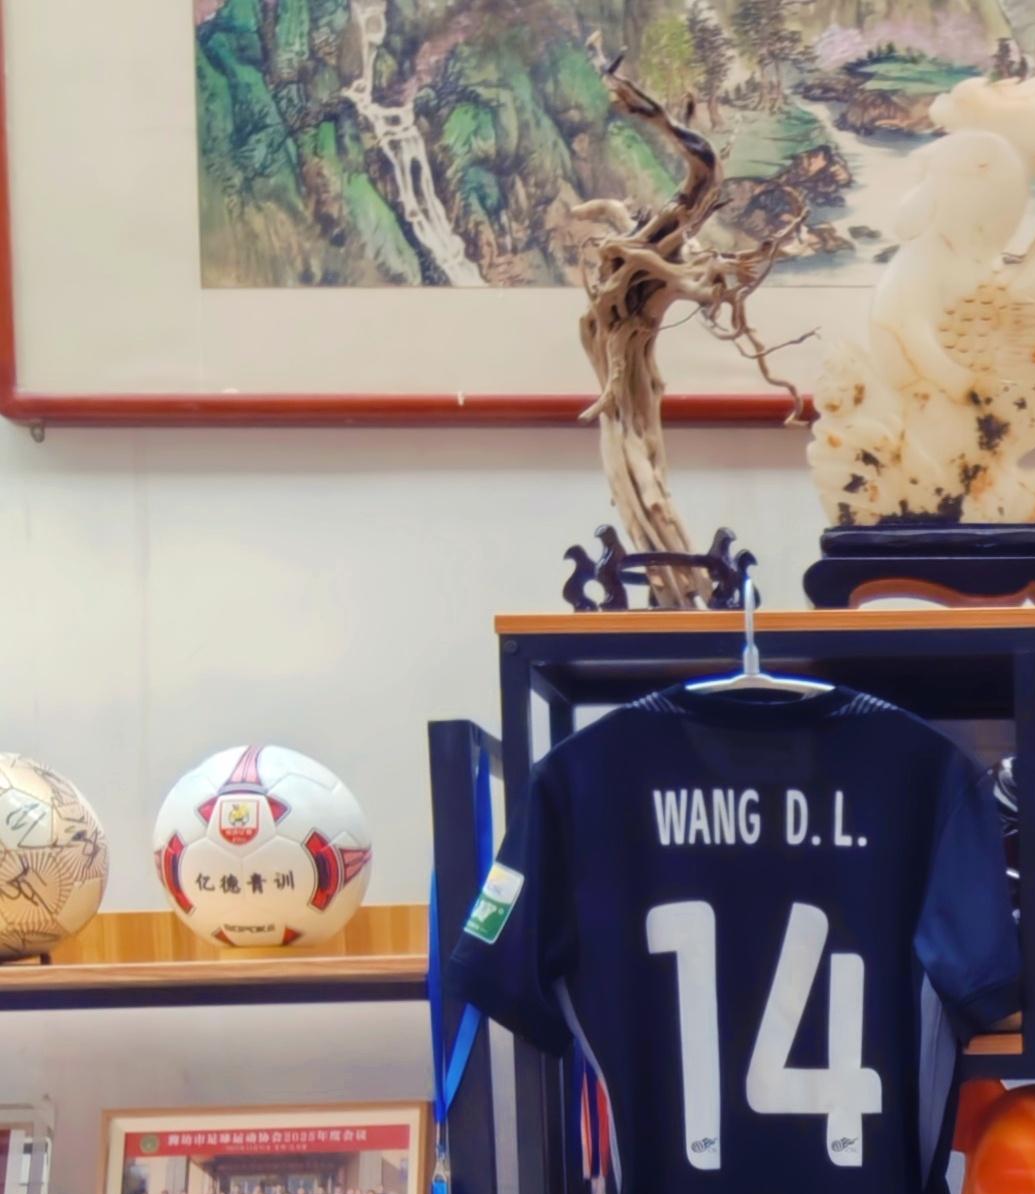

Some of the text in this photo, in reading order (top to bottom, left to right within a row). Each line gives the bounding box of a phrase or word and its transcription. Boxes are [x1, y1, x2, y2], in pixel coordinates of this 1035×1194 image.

[653, 788, 759, 846] WANG
[195, 870, 295, 894] 亿德青训
[646, 900, 882, 1170] 14
